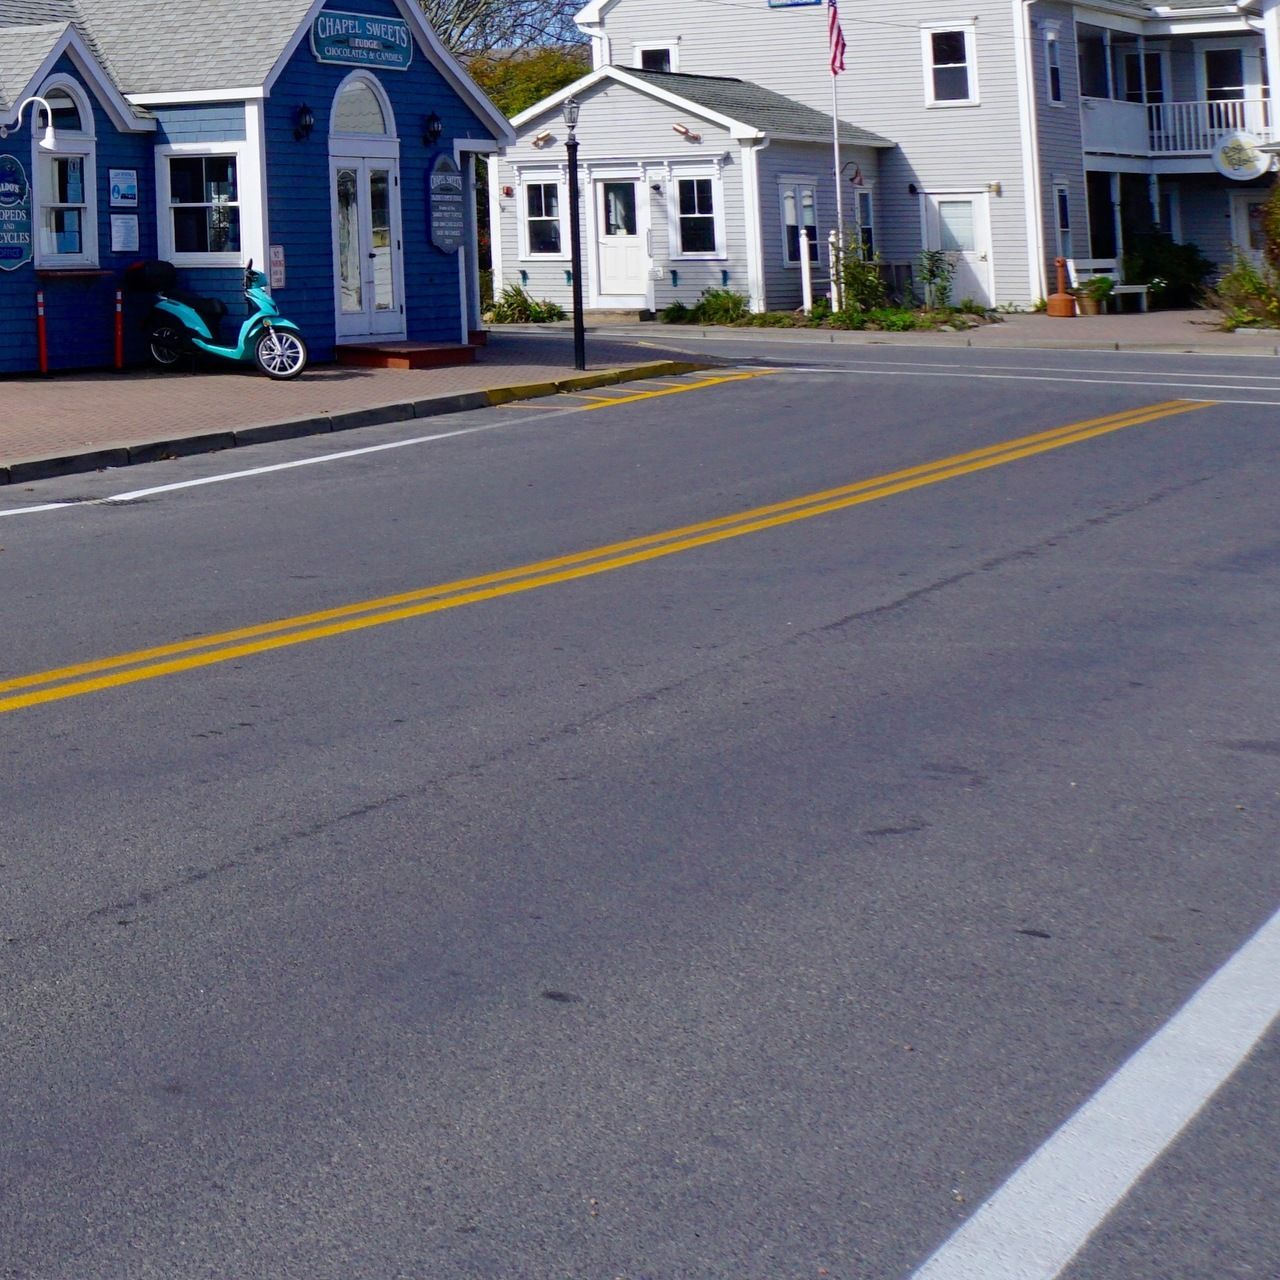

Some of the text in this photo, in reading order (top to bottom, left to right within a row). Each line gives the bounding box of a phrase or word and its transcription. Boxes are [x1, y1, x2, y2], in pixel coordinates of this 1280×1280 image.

[318, 17, 407, 47] CHAPEL SWEETS
[355, 39, 378, 49] FUDGE
[324, 47, 367, 59] CHOCOLATES
[376, 52, 403, 62] CANDIES
